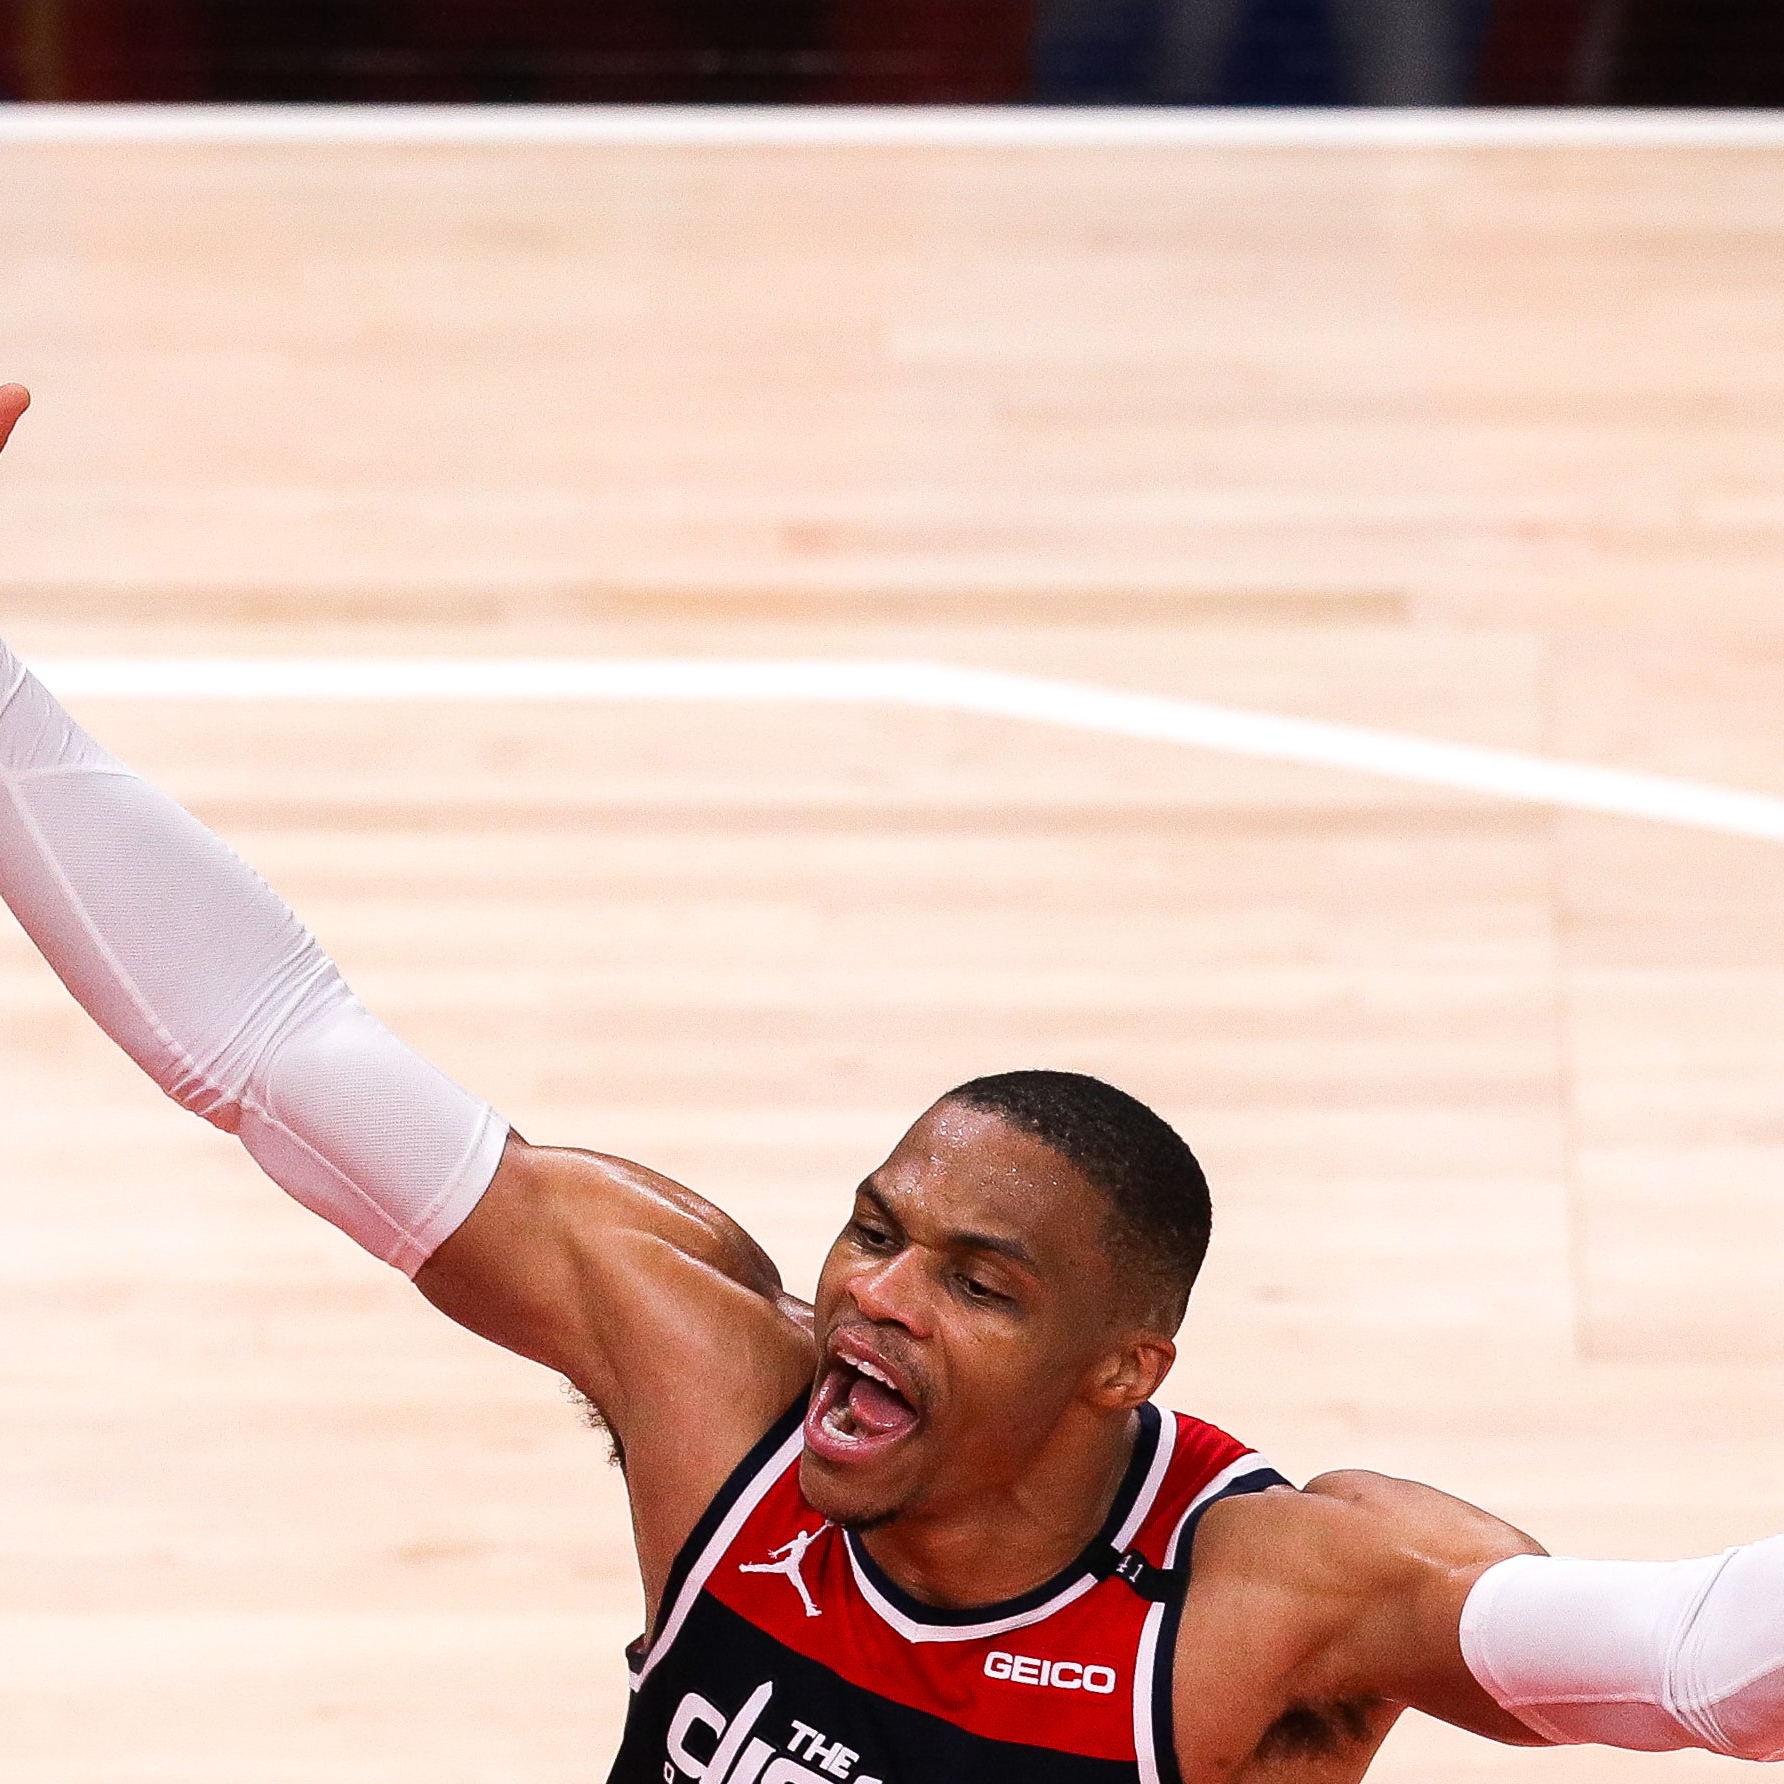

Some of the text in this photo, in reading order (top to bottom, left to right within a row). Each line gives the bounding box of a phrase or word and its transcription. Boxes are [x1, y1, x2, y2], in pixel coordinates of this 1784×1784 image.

[1115, 1554, 1144, 1583] 41
[983, 1651, 1116, 1695] GEICO
[790, 1719, 860, 1780] THE
